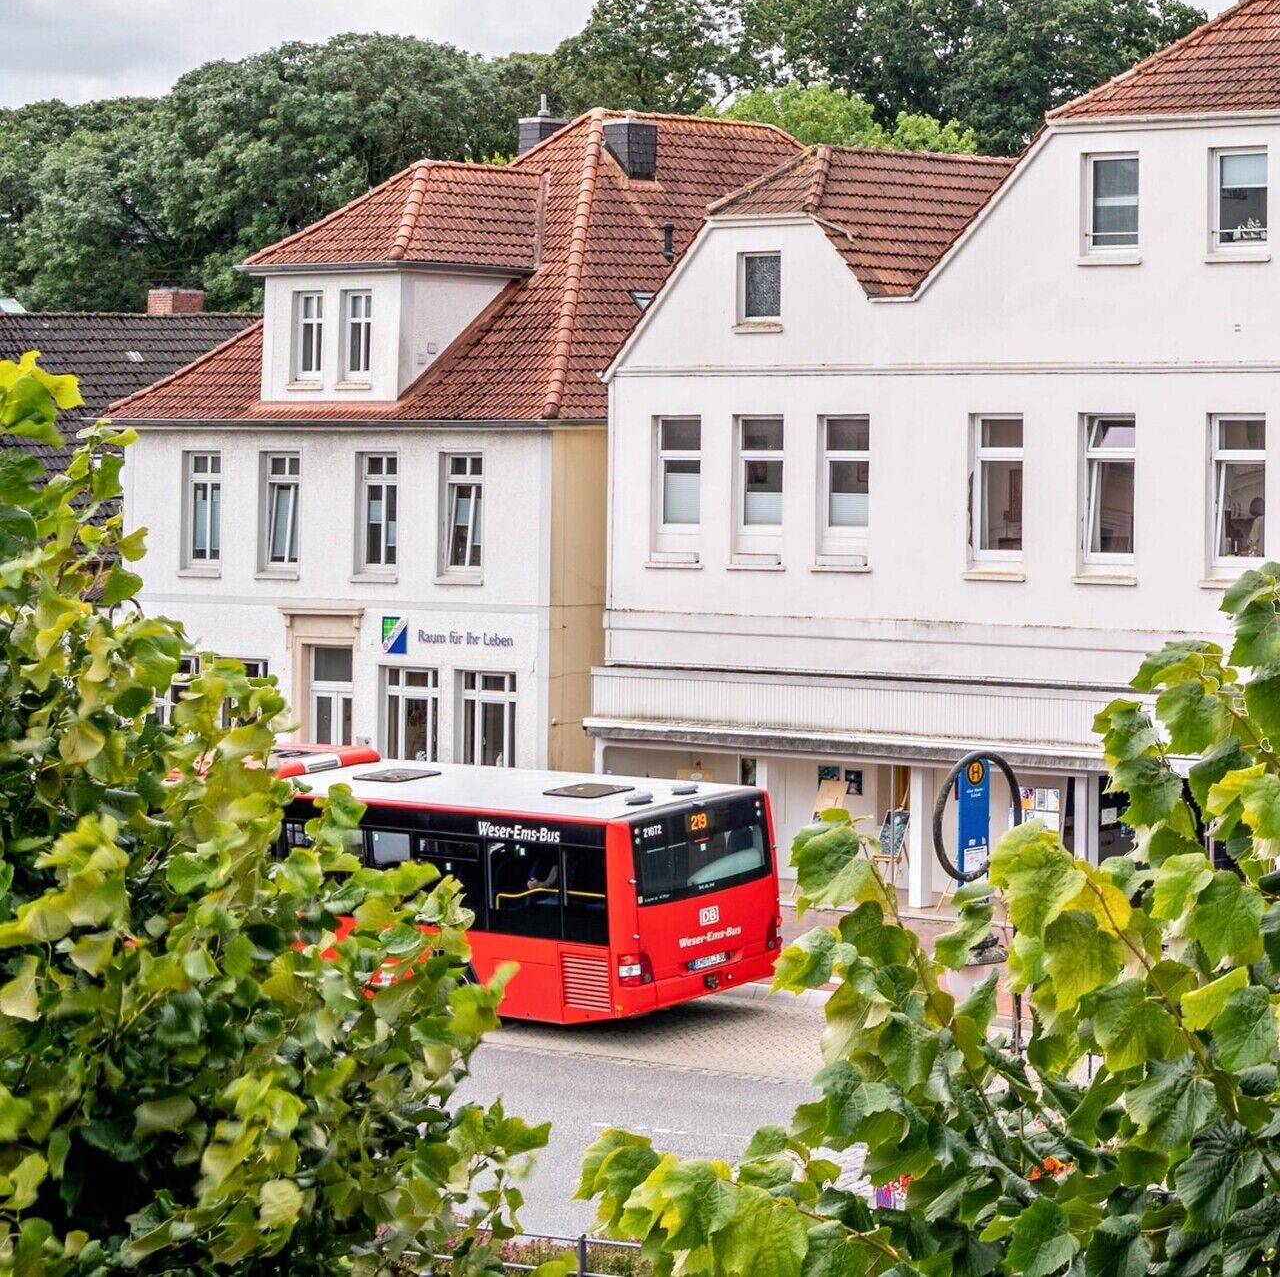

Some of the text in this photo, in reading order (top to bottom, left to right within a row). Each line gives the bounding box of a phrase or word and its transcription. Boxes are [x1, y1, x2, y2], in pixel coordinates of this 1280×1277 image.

[418, 629, 446, 643] Raum
[449, 631, 464, 645] für
[466, 632, 480, 645] Ihr
[483, 632, 514, 647] Leben
[971, 765, 981, 781] H
[690, 813, 708, 830] 219
[478, 821, 561, 843] Weser-Ems-Bus
[643, 825, 663, 838] 21072
[702, 908, 717, 923] DB
[679, 926, 742, 949] Weser-Ems-Bus
